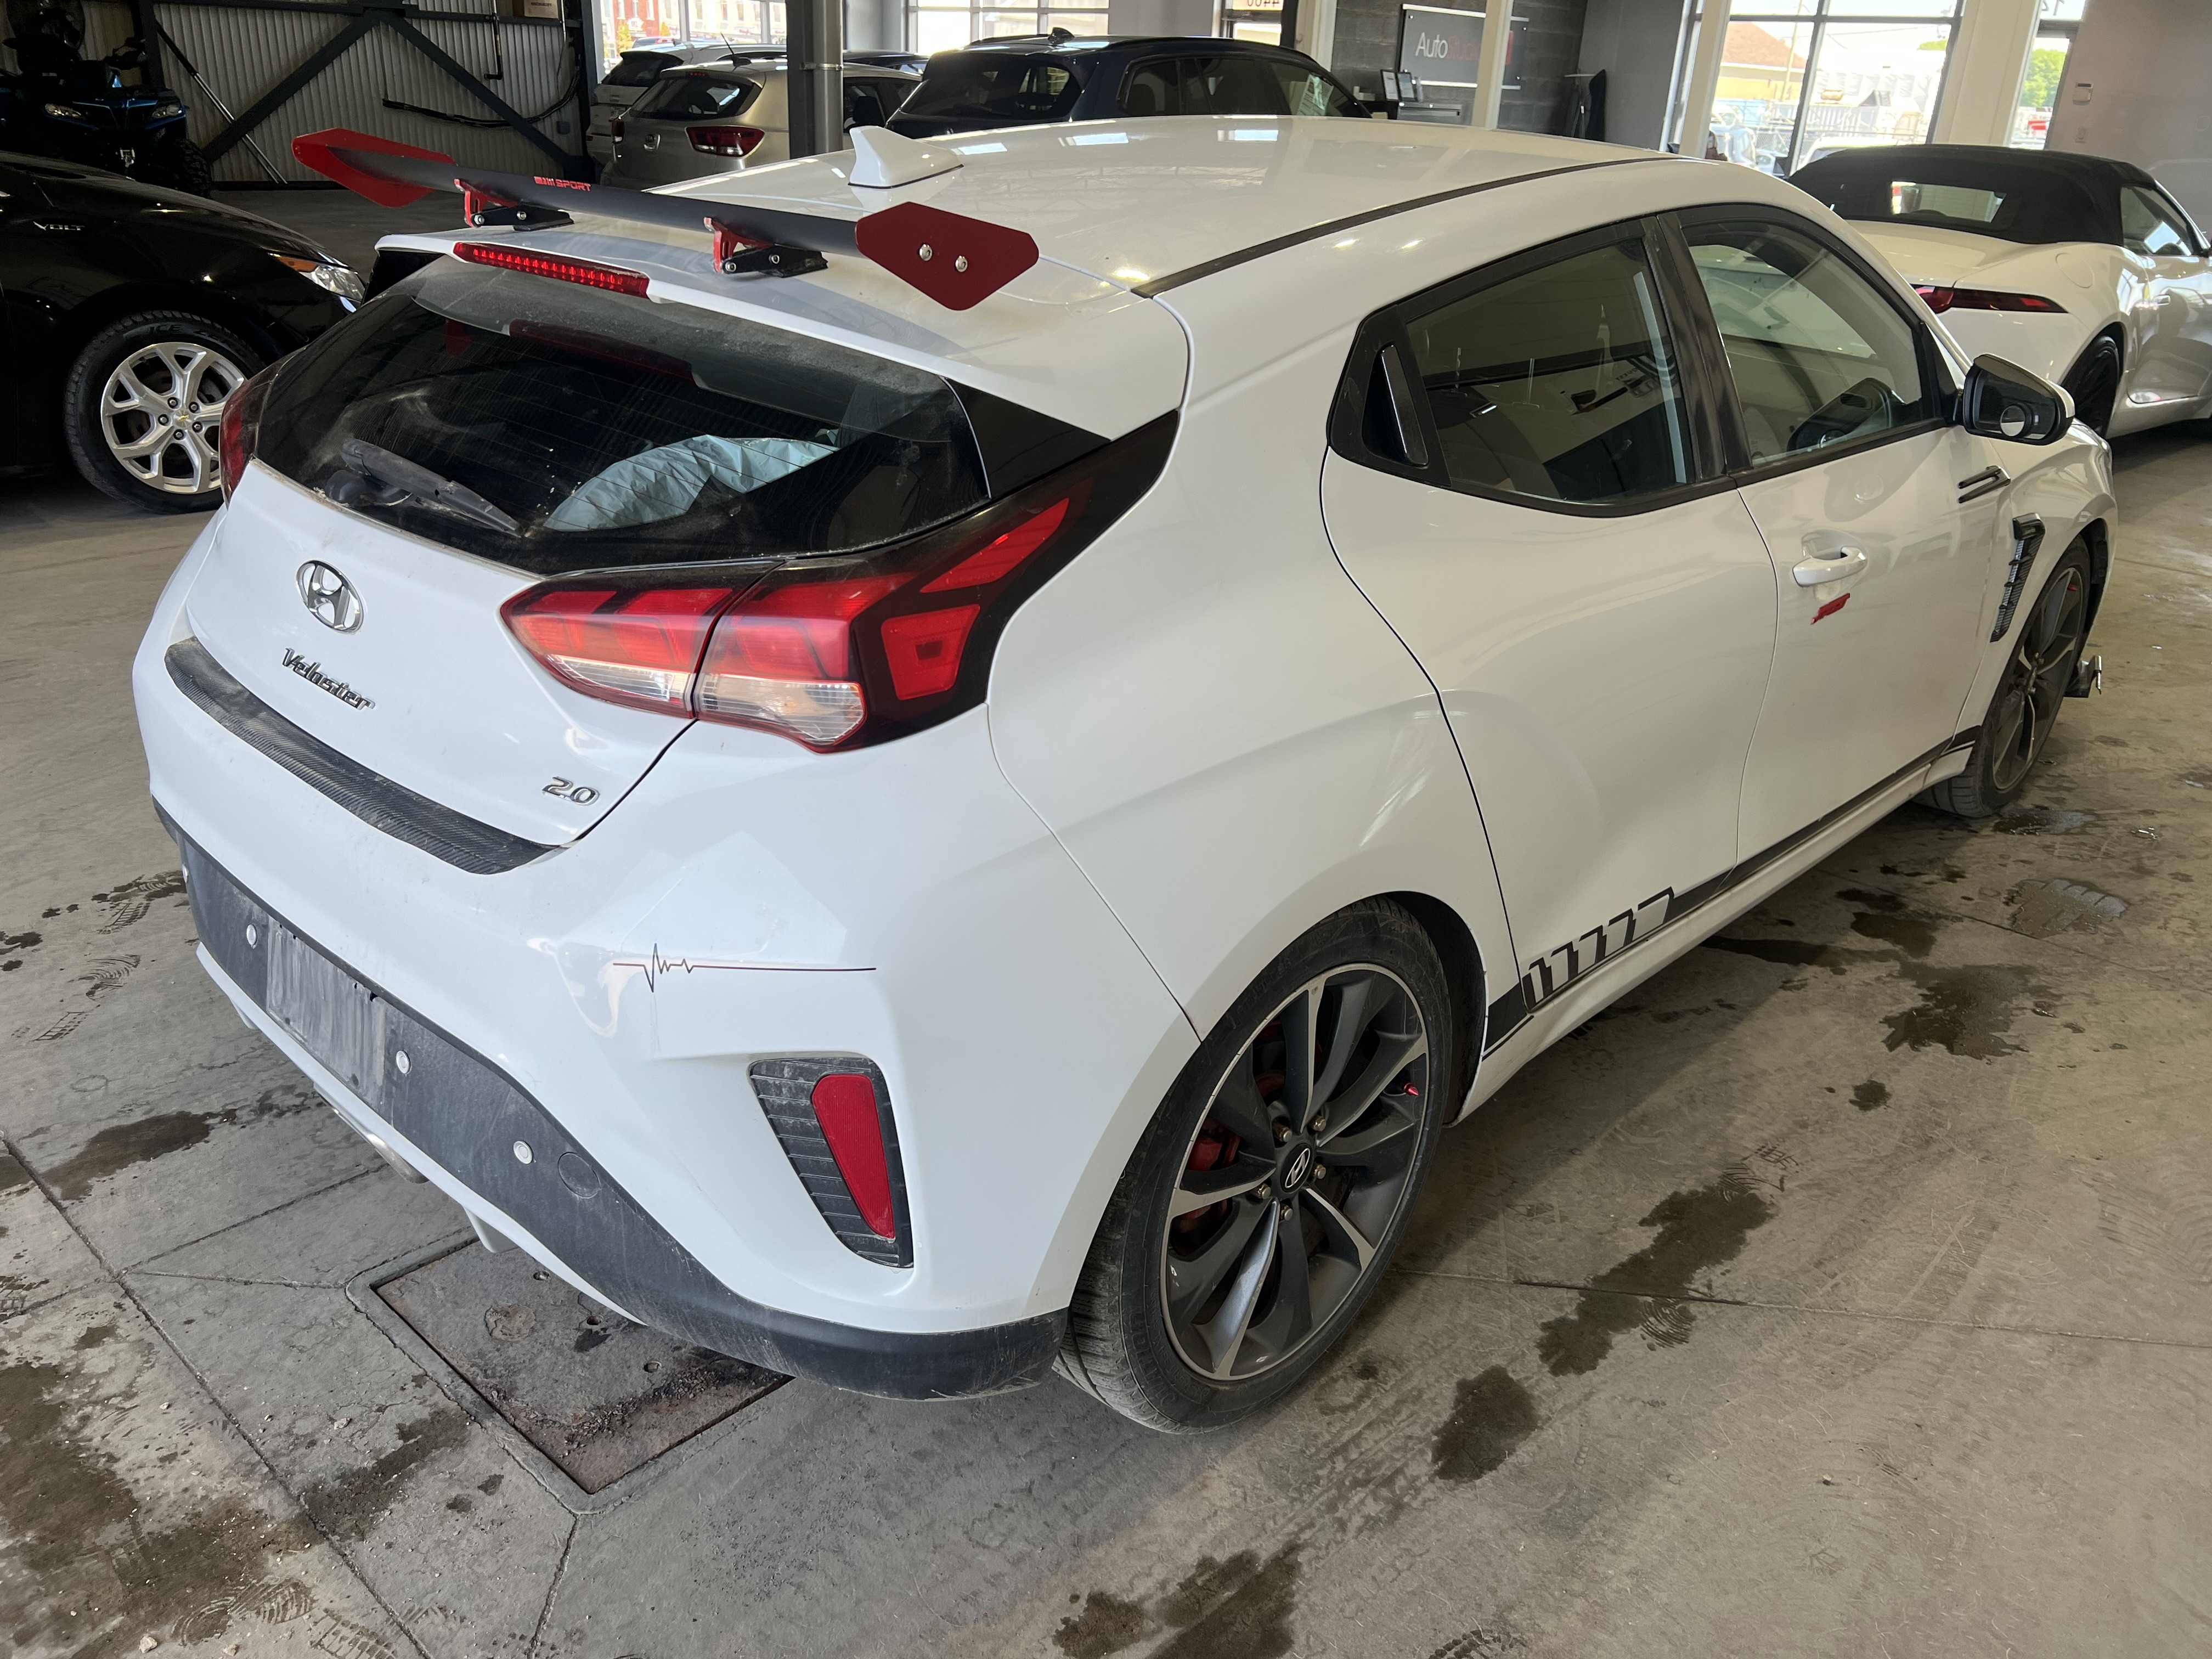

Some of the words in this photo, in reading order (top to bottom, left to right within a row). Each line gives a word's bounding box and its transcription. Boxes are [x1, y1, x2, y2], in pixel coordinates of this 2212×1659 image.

[555, 179, 591, 191] SPORT
[33, 221, 85, 230] VOLT
[282, 647, 376, 710] Veloster
